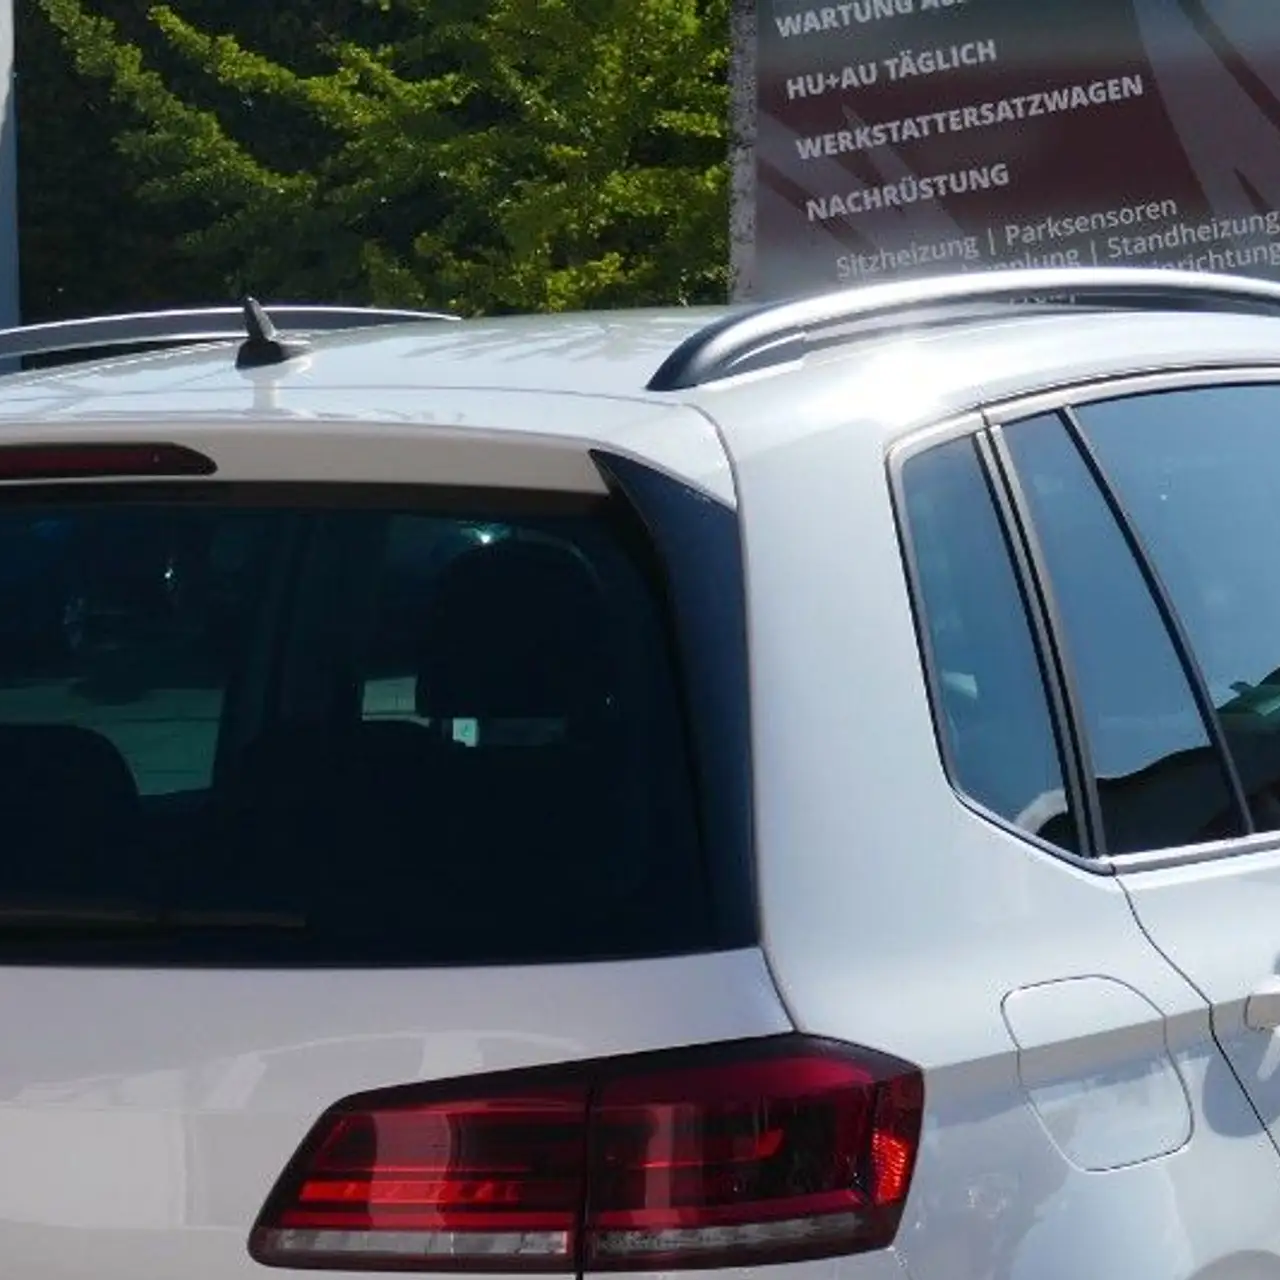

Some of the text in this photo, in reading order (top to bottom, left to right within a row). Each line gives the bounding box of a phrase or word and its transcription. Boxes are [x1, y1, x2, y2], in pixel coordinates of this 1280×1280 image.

[775, 0, 914, 38] WARTUNG
[786, 39, 997, 100] HU+AU TÄGLICH
[795, 75, 1145, 160] WERKSTATTERSATZWAGEN
[806, 163, 1010, 222] NACHRÜSTUNG
[836, 235, 980, 279] Sitzheizung
[1005, 199, 1178, 246] Parksensoren
